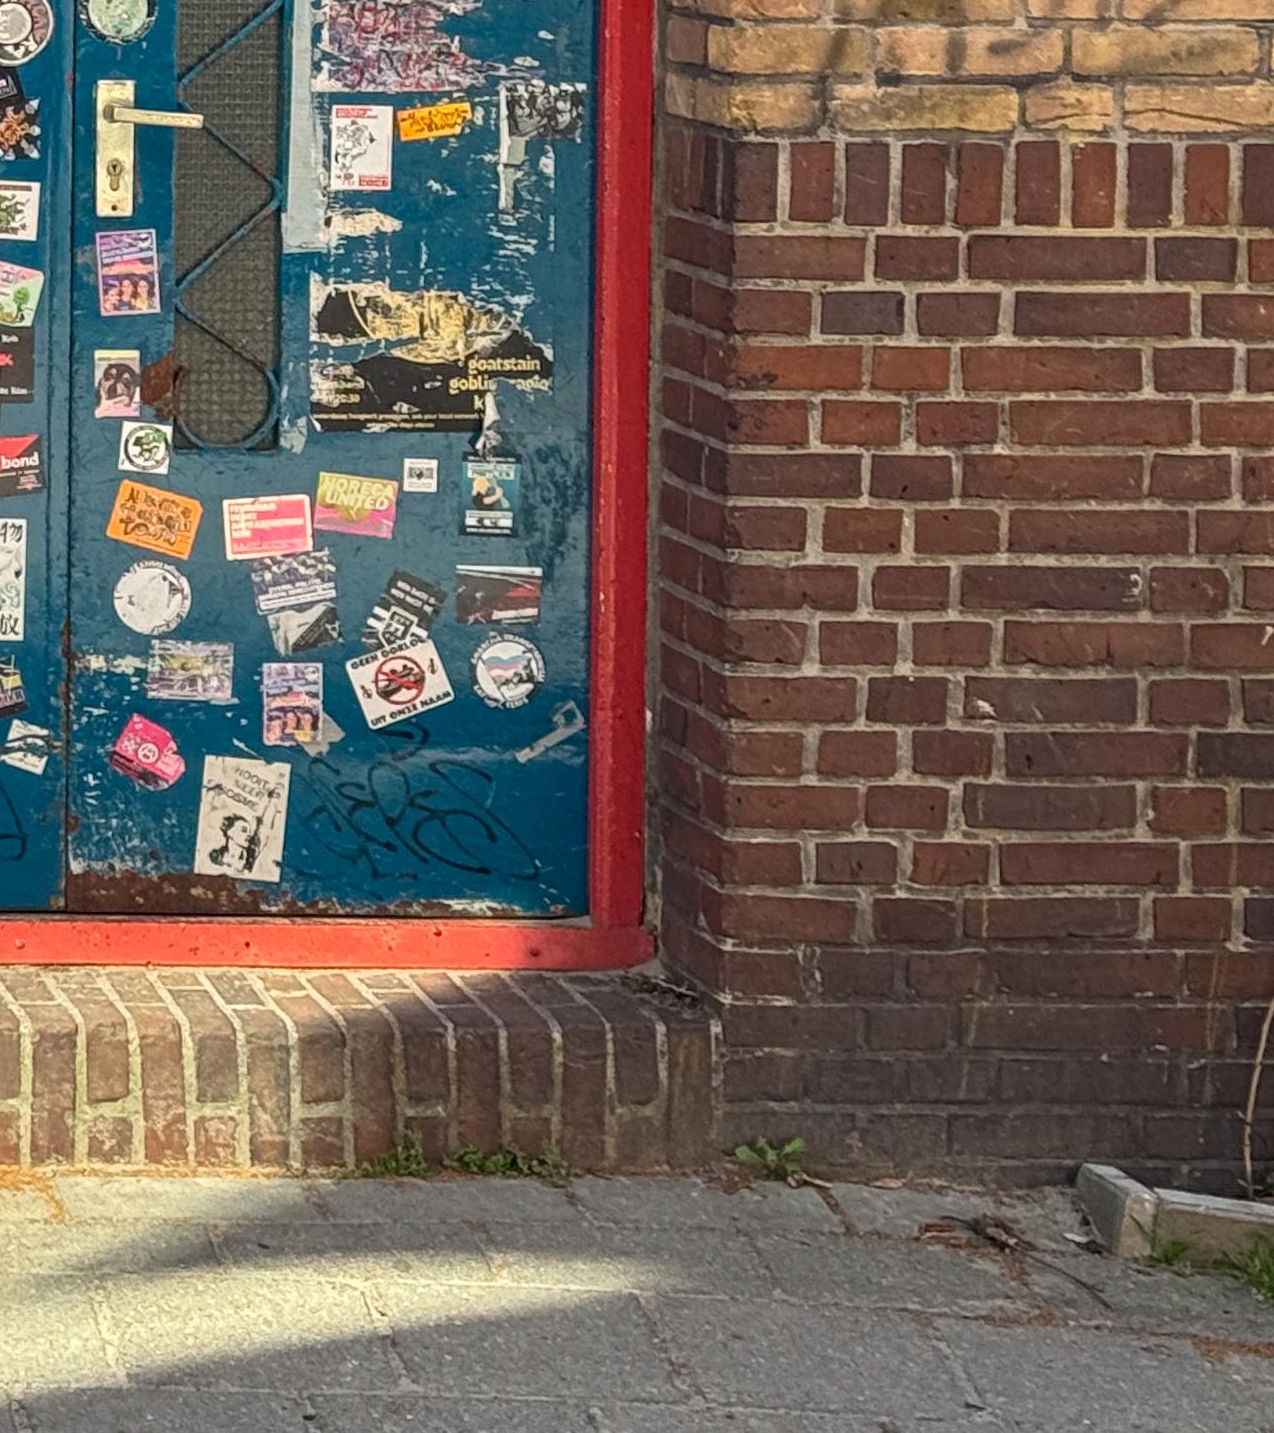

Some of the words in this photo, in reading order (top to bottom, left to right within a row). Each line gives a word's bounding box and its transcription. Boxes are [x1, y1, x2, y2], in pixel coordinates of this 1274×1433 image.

[469, 356, 540, 373] goatstain
[1, 451, 40, 470] bond
[321, 477, 394, 497] HORECA
[325, 492, 389, 511] UNITED
[351, 653, 380, 670] GEEN
[371, 715, 388, 727] UIT
[389, 704, 420, 721] ONZE
[420, 691, 452, 710] NAAM
